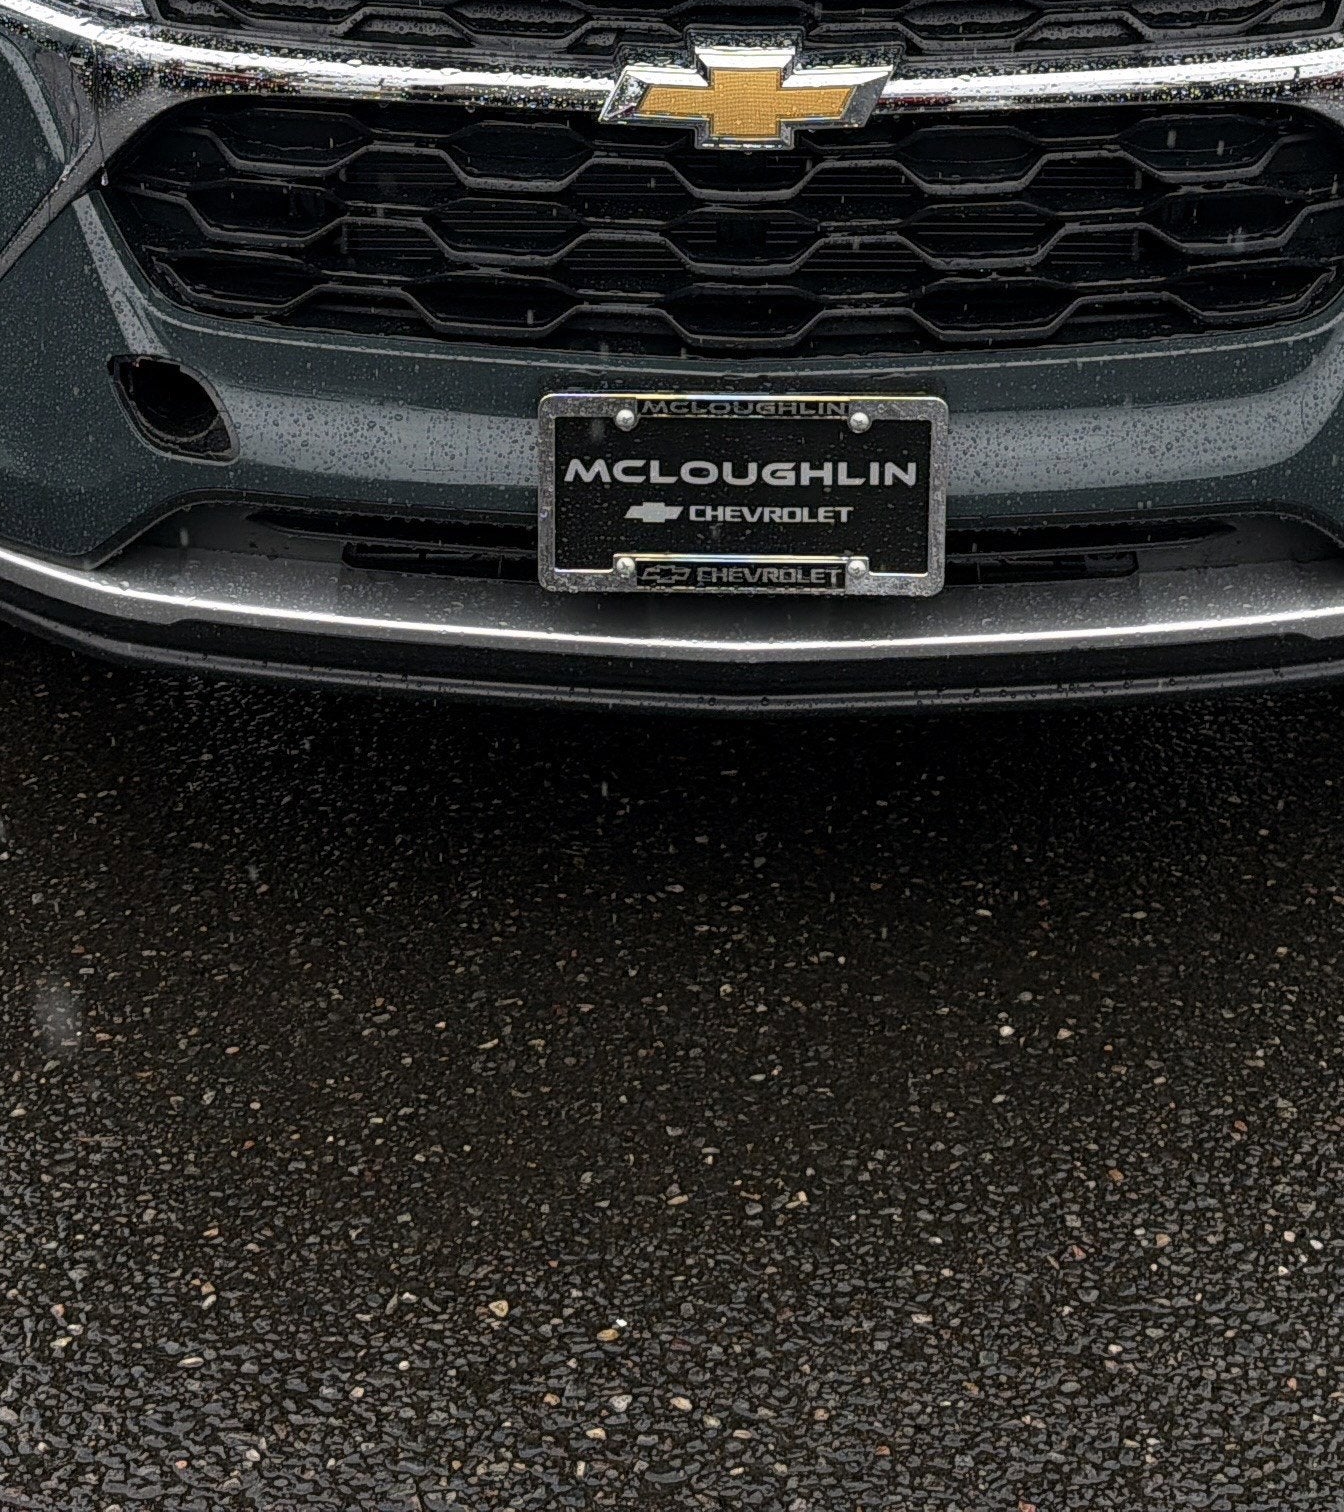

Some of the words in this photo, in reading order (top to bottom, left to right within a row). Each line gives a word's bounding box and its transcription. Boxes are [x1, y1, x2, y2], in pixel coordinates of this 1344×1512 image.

[641, 400, 848, 416] MCLOUGHLIN
[564, 458, 917, 487] MCLOUGHLIN
[689, 505, 854, 524] CHEVROLET
[697, 565, 843, 585] CHEVROLET
